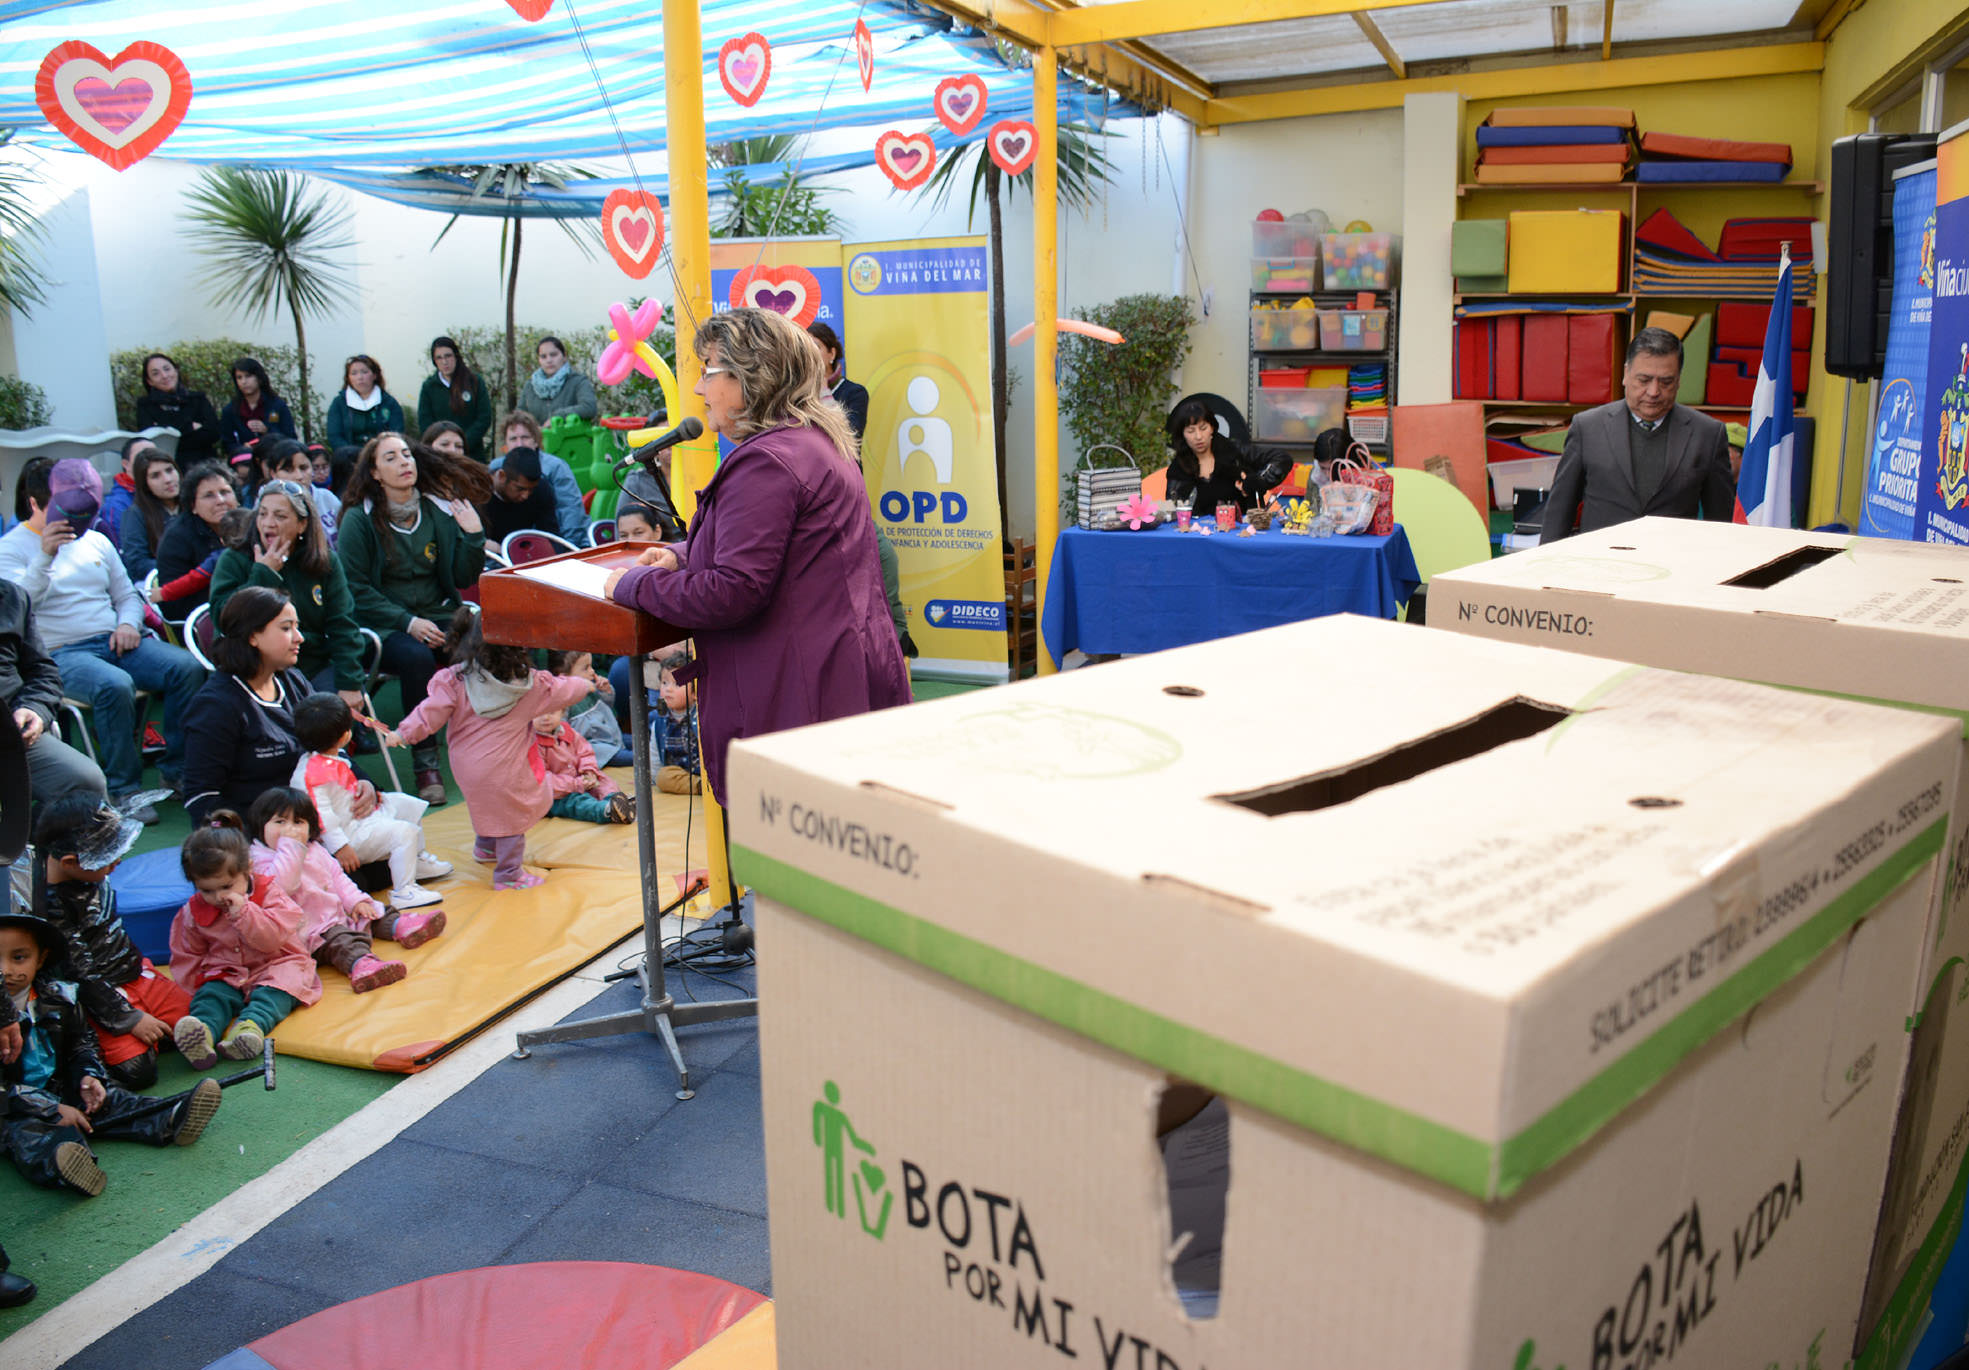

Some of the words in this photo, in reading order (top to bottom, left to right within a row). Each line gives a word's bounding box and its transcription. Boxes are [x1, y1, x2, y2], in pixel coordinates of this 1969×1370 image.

[895, 260, 966, 270] MUNICIPALIDAD
[924, 270, 948, 281] DEL
[952, 268, 982, 280] MAR
[880, 490, 968, 524] OPD
[886, 527, 896, 537] DE
[897, 527, 942, 537] PROTECCIÓN
[945, 529, 955, 537] DE
[957, 529, 994, 540] DERECHOS
[930, 541, 985, 551] ADOLESCENCIA
[952, 605, 1000, 617] DIDECO
[1485, 605, 1593, 637] CONVENIO:
[789, 803, 920, 879] CONVENIO:
[902, 1159, 1046, 1281] BOTA
[1668, 1249, 1721, 1361] MI
[1734, 1158, 1804, 1281] VIDA
[1592, 1197, 1704, 1370] BOTA
[944, 1251, 1006, 1310] POR
[1013, 1283, 1078, 1358] MI
